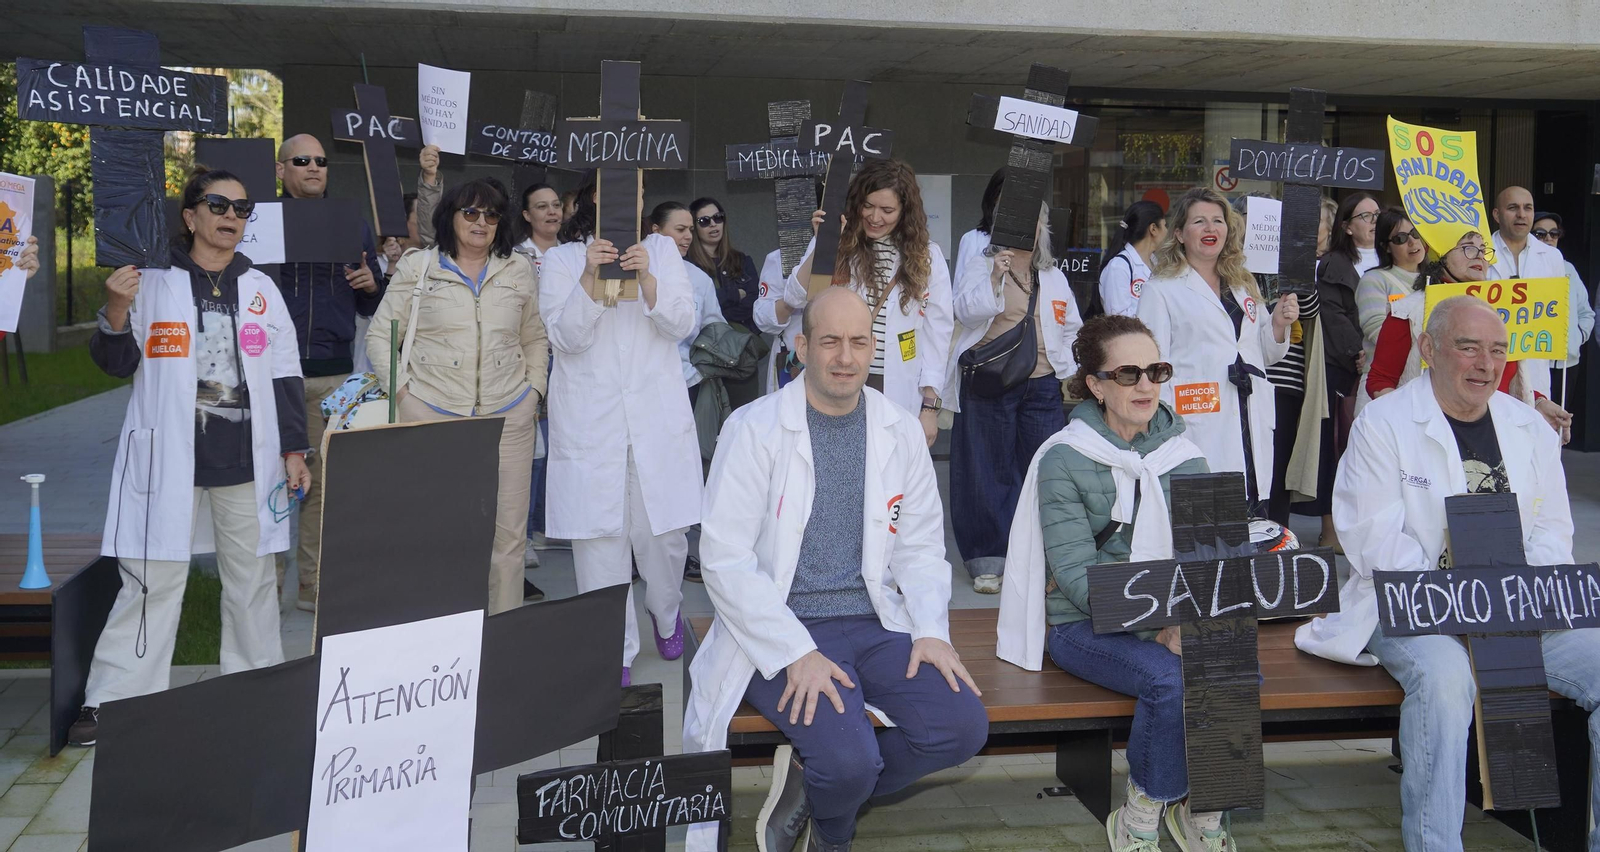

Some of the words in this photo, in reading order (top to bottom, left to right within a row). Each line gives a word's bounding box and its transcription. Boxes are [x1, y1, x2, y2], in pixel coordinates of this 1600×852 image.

[48, 63, 188, 97] CALIDADE
[431, 86, 446, 95] SIN
[29, 89, 212, 123] ASISTENCIAL
[421, 94, 457, 108] MÉDICOS
[424, 105, 434, 115] NO
[435, 108, 454, 119] HAY
[345, 112, 406, 140] PAC
[421, 116, 456, 130] SANIDAD
[1002, 111, 1071, 139] SANIDAD
[568, 126, 682, 163] MEDICINA
[814, 123, 882, 155] PAC
[1393, 124, 1464, 161] SOS
[491, 142, 512, 157] DE
[518, 147, 557, 165] SAÚD
[738, 146, 801, 172] MÉDICA
[1238, 146, 1376, 182] DOMICILIOS
[1251, 223, 1281, 232] MÉDIC
[1264, 214, 1277, 222] SIN
[1249, 243, 1280, 252] SANIDA
[1466, 283, 1528, 305] SOS
[1497, 300, 1559, 325] DADE
[151, 327, 187, 337] MÉDICOS
[244, 328, 260, 336] STOP
[152, 345, 182, 354] HUELGA
[1179, 387, 1216, 397] MÉDICOS
[1181, 402, 1214, 411] HUELGA
[1122, 554, 1329, 628] SALUD
[1384, 573, 1492, 630] MÉDICO
[319, 657, 473, 732] ATENCIÓN
[321, 744, 437, 806] PRIMARIA
[535, 760, 666, 818] FARMACIA
[558, 784, 726, 840] COMUNITARIA
